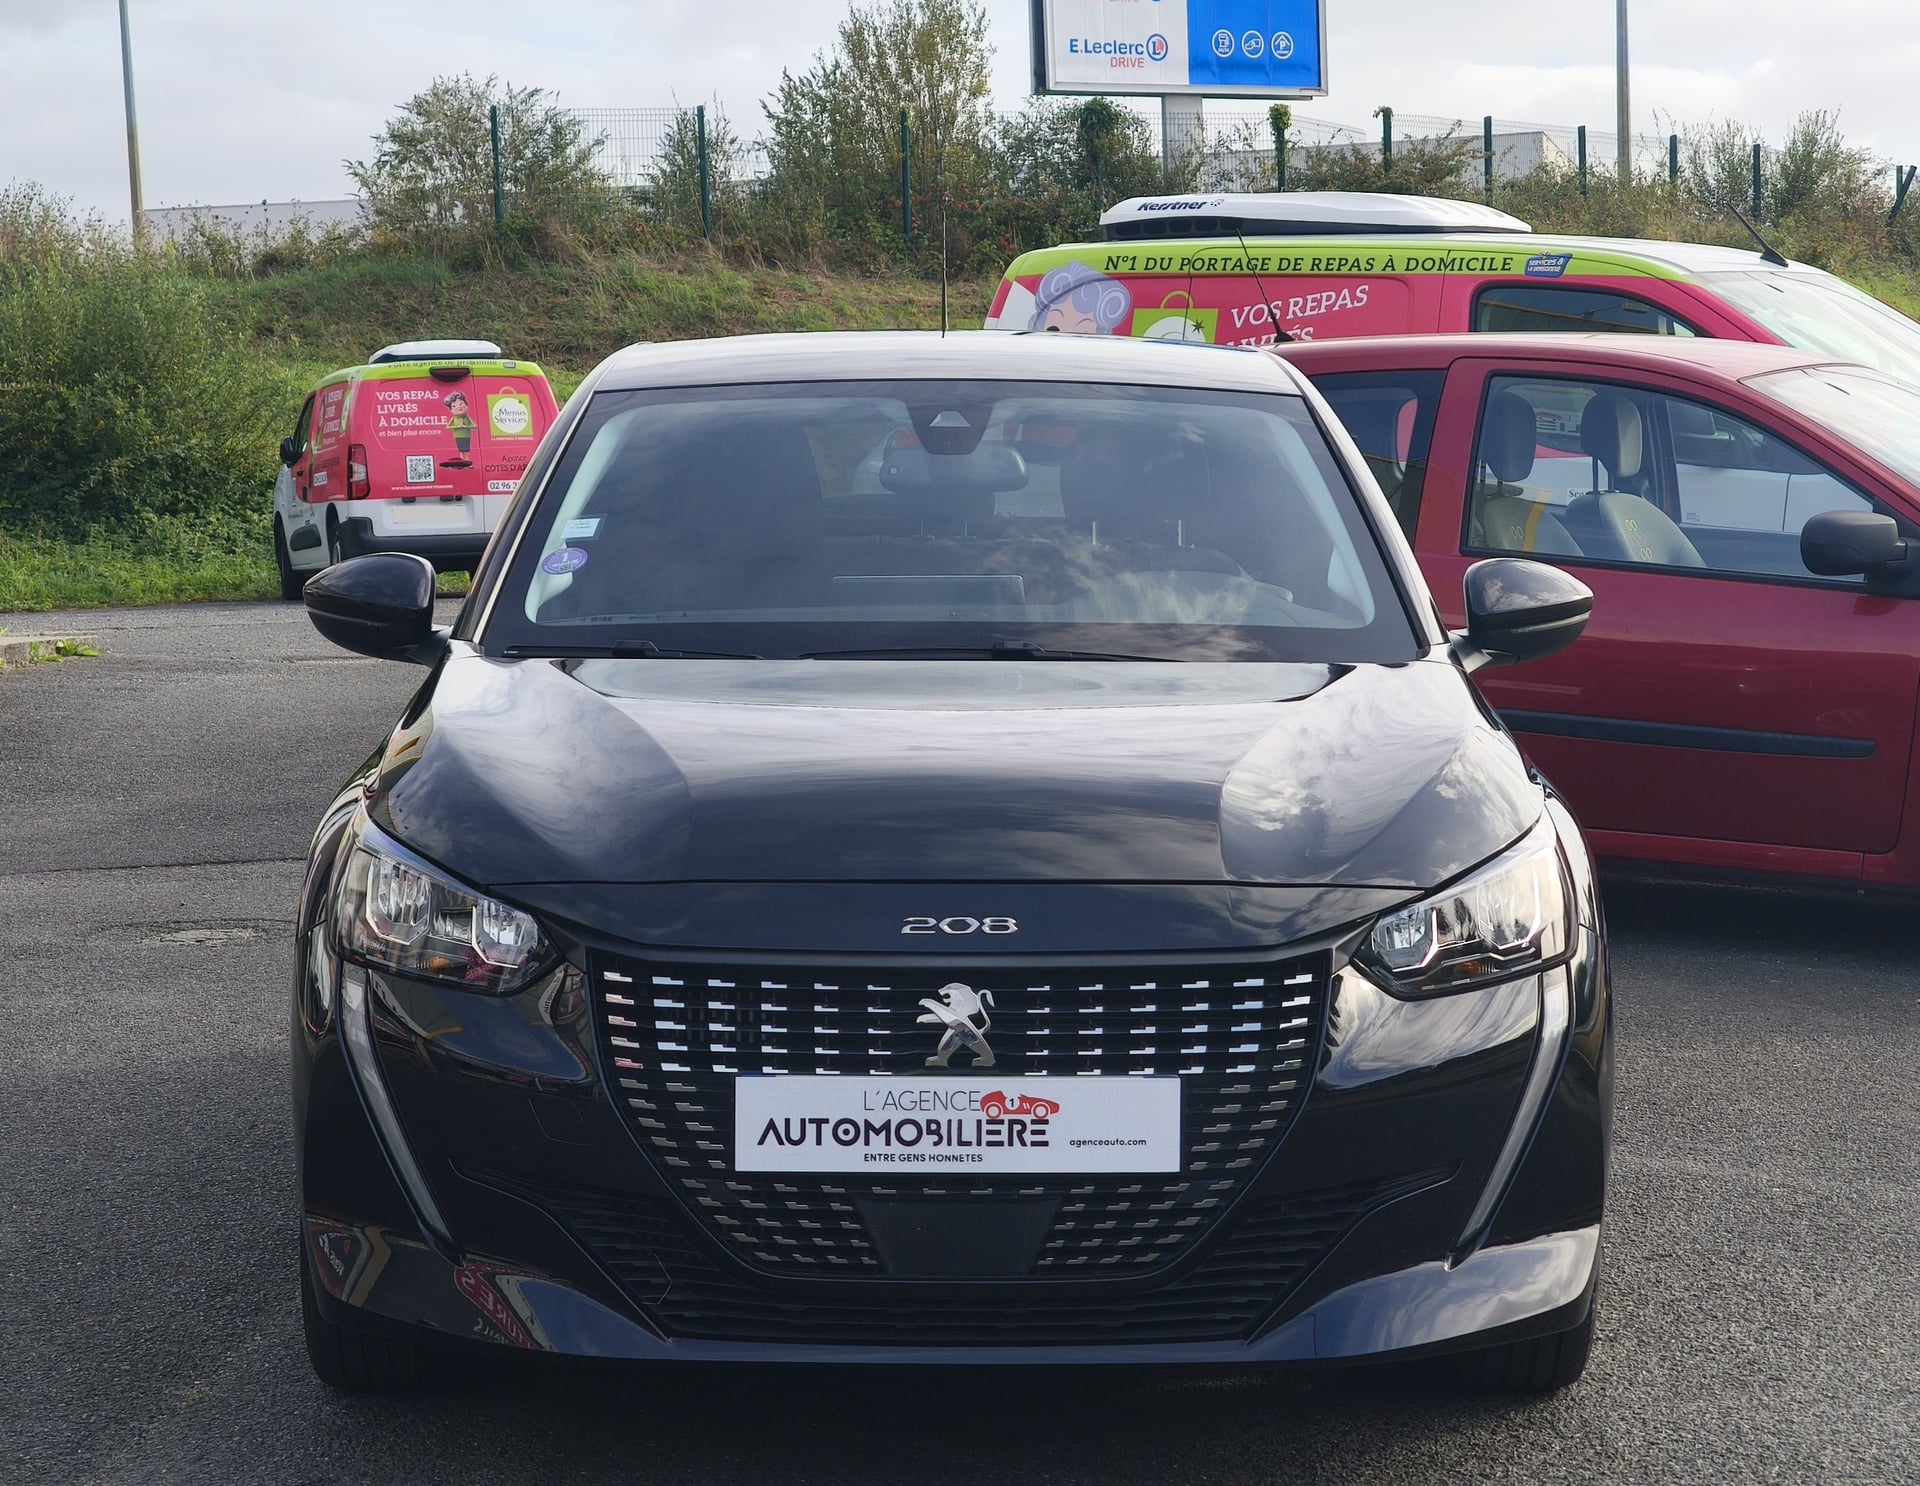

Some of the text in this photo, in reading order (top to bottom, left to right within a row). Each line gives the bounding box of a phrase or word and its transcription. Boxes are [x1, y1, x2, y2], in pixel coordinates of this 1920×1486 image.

[1069, 38, 1144, 55] E.Leclerc
[1110, 56, 1145, 68] DRIVE
[1137, 199, 1207, 212] Kerstner
[1105, 254, 1513, 272] N°1 DU PORTAGE DE REPAS À DOMICILE
[1231, 284, 1369, 329] VOS REPAS
[376, 390, 439, 400] VOS REPAS
[377, 402, 418, 414] LIVRÉS
[498, 408, 527, 417] Menus
[379, 415, 448, 427] À DOMICILE
[494, 416, 528, 424] Services
[403, 429, 418, 438] plus
[502, 455, 528, 463] Agence
[489, 482, 500, 490] 02
[501, 482, 511, 490] 96
[901, 917, 1018, 934] 208
[863, 1090, 981, 1112] L'AGENCE
[756, 1117, 1050, 1147] AUTOMOBILIERE
[1069, 1137, 1147, 1148] agenceauto.com
[864, 1153, 983, 1163] ENTRE GENS HONNETES
